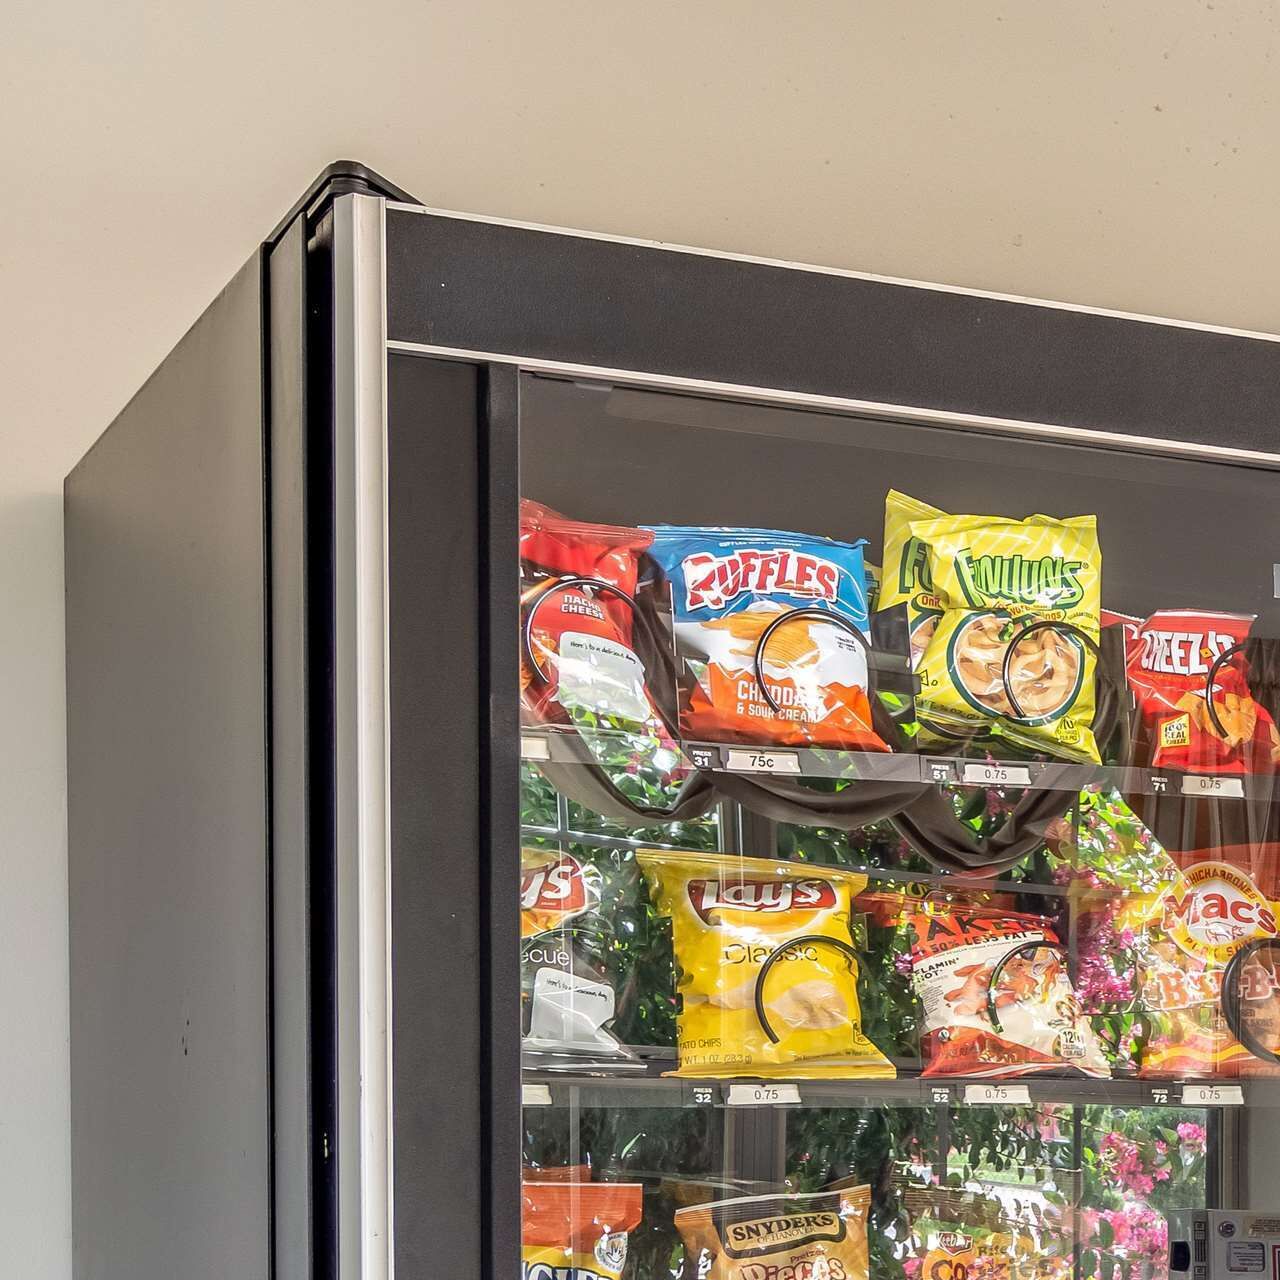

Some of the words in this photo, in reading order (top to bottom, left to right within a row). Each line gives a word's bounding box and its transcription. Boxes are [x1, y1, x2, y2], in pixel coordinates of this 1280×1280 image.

[683, 550, 838, 609] RUFFLES
[736, 702, 745, 714] &
[748, 703, 779, 718] SOUR
[694, 757, 709, 767] 31
[933, 770, 947, 779] 51
[984, 769, 1008, 780] 0.75
[1153, 782, 1166, 791] 71
[1200, 779, 1221, 790] 0.75
[1163, 892, 1278, 934] Mac's
[965, 933, 1000, 947] LESS
[1003, 931, 1029, 941] FAT
[723, 943, 819, 964] Classic
[698, 1038, 722, 1048] CHIPS
[695, 1094, 712, 1103] 32
[754, 1089, 779, 1100] 0.75
[933, 1094, 949, 1103] 52
[985, 1088, 1008, 1099] 0.75
[1153, 1094, 1168, 1103] 72
[1199, 1089, 1221, 1100] 0.75
[732, 1214, 835, 1242] SNYDER'S
